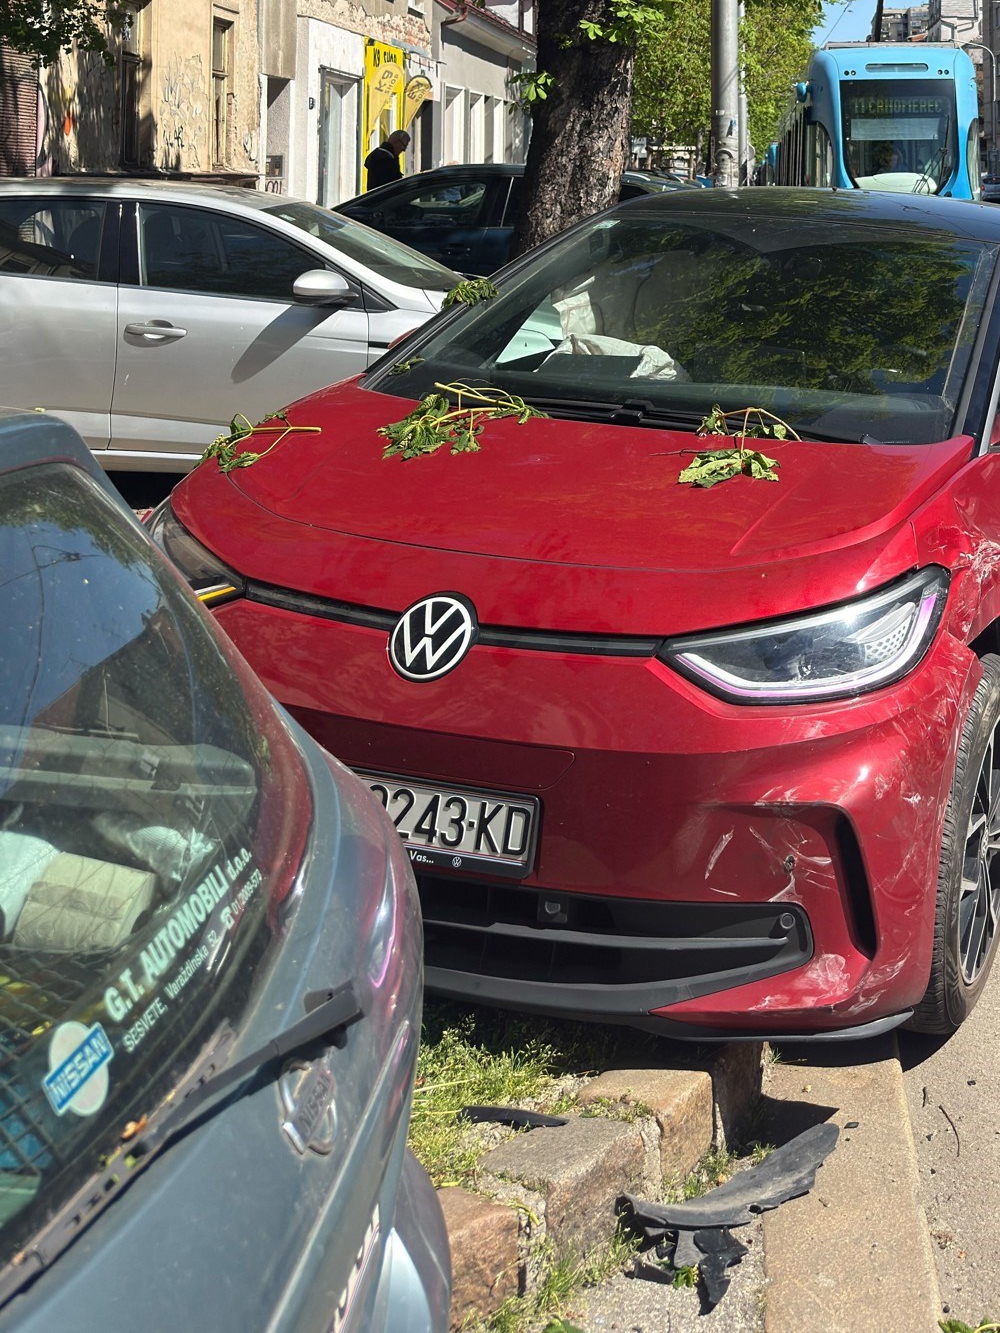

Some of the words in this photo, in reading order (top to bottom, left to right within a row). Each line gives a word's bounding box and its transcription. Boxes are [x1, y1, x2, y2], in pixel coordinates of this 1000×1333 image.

[854, 97, 865, 114] 11
[104, 968, 145, 1022] G.T.
[140, 864, 230, 984] AUTOMOBILI
[227, 847, 252, 881] d.o.o.
[122, 996, 169, 1053] SESVETE,
[165, 944, 210, 1000] Varaždinska
[49, 1031, 108, 1105] NISSAN
